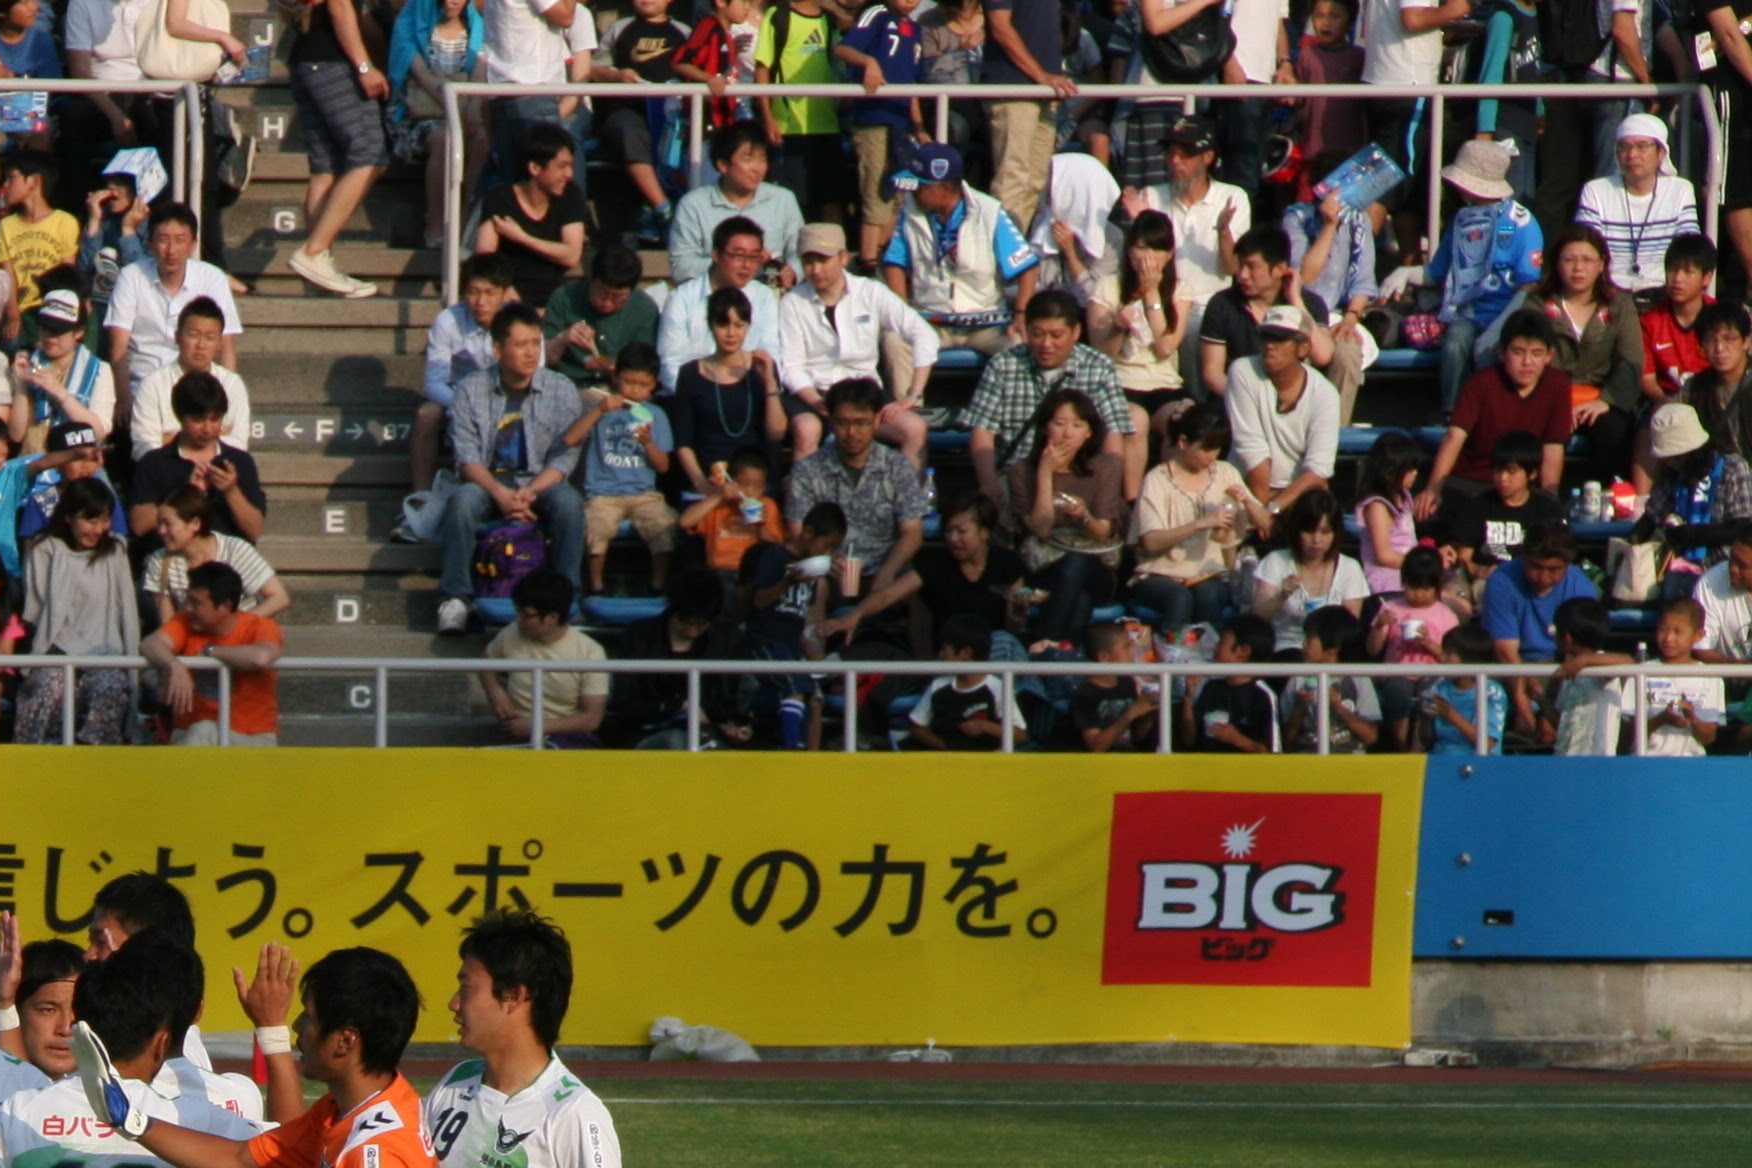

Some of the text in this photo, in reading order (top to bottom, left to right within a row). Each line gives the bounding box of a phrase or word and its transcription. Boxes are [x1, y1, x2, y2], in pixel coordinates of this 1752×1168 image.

[254, 23, 274, 46] J
[888, 34, 900, 57] 7
[262, 116, 284, 138] H
[274, 210, 296, 233] G
[250, 420, 265, 439] 8
[315, 419, 335, 442] F
[325, 509, 345, 533] E
[336, 598, 359, 623] D
[350, 685, 372, 709] C
[1136, 862, 1340, 933] BIG
[429, 1107, 470, 1161] 19
